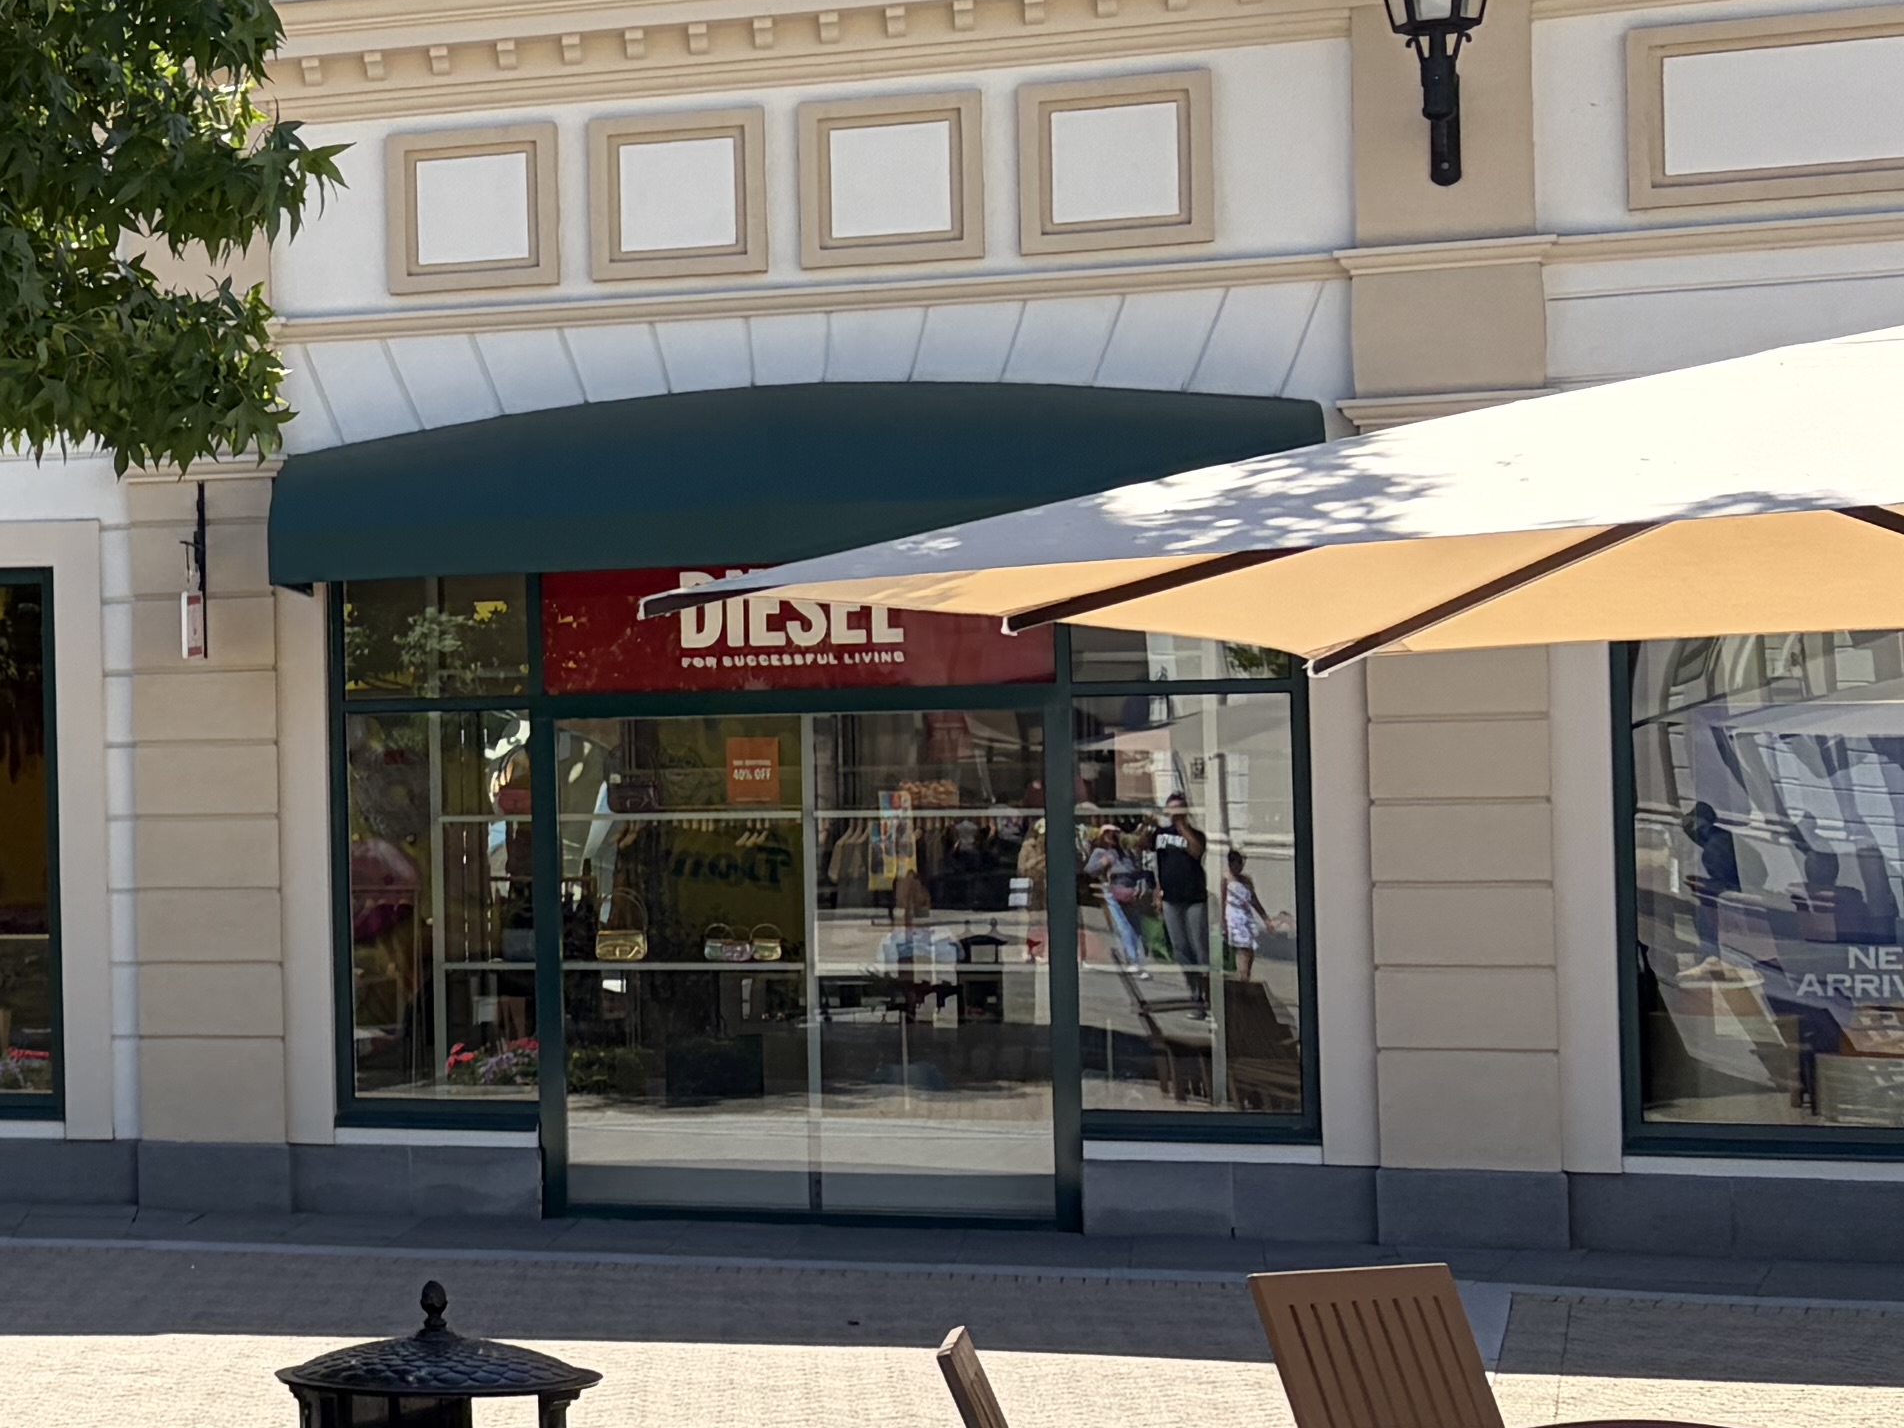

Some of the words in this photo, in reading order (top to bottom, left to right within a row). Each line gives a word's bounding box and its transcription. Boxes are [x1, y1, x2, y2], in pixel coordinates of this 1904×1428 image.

[681, 656, 717, 669] FOR
[722, 652, 838, 667] SUCCESSFUL
[844, 651, 905, 664] LIVING
